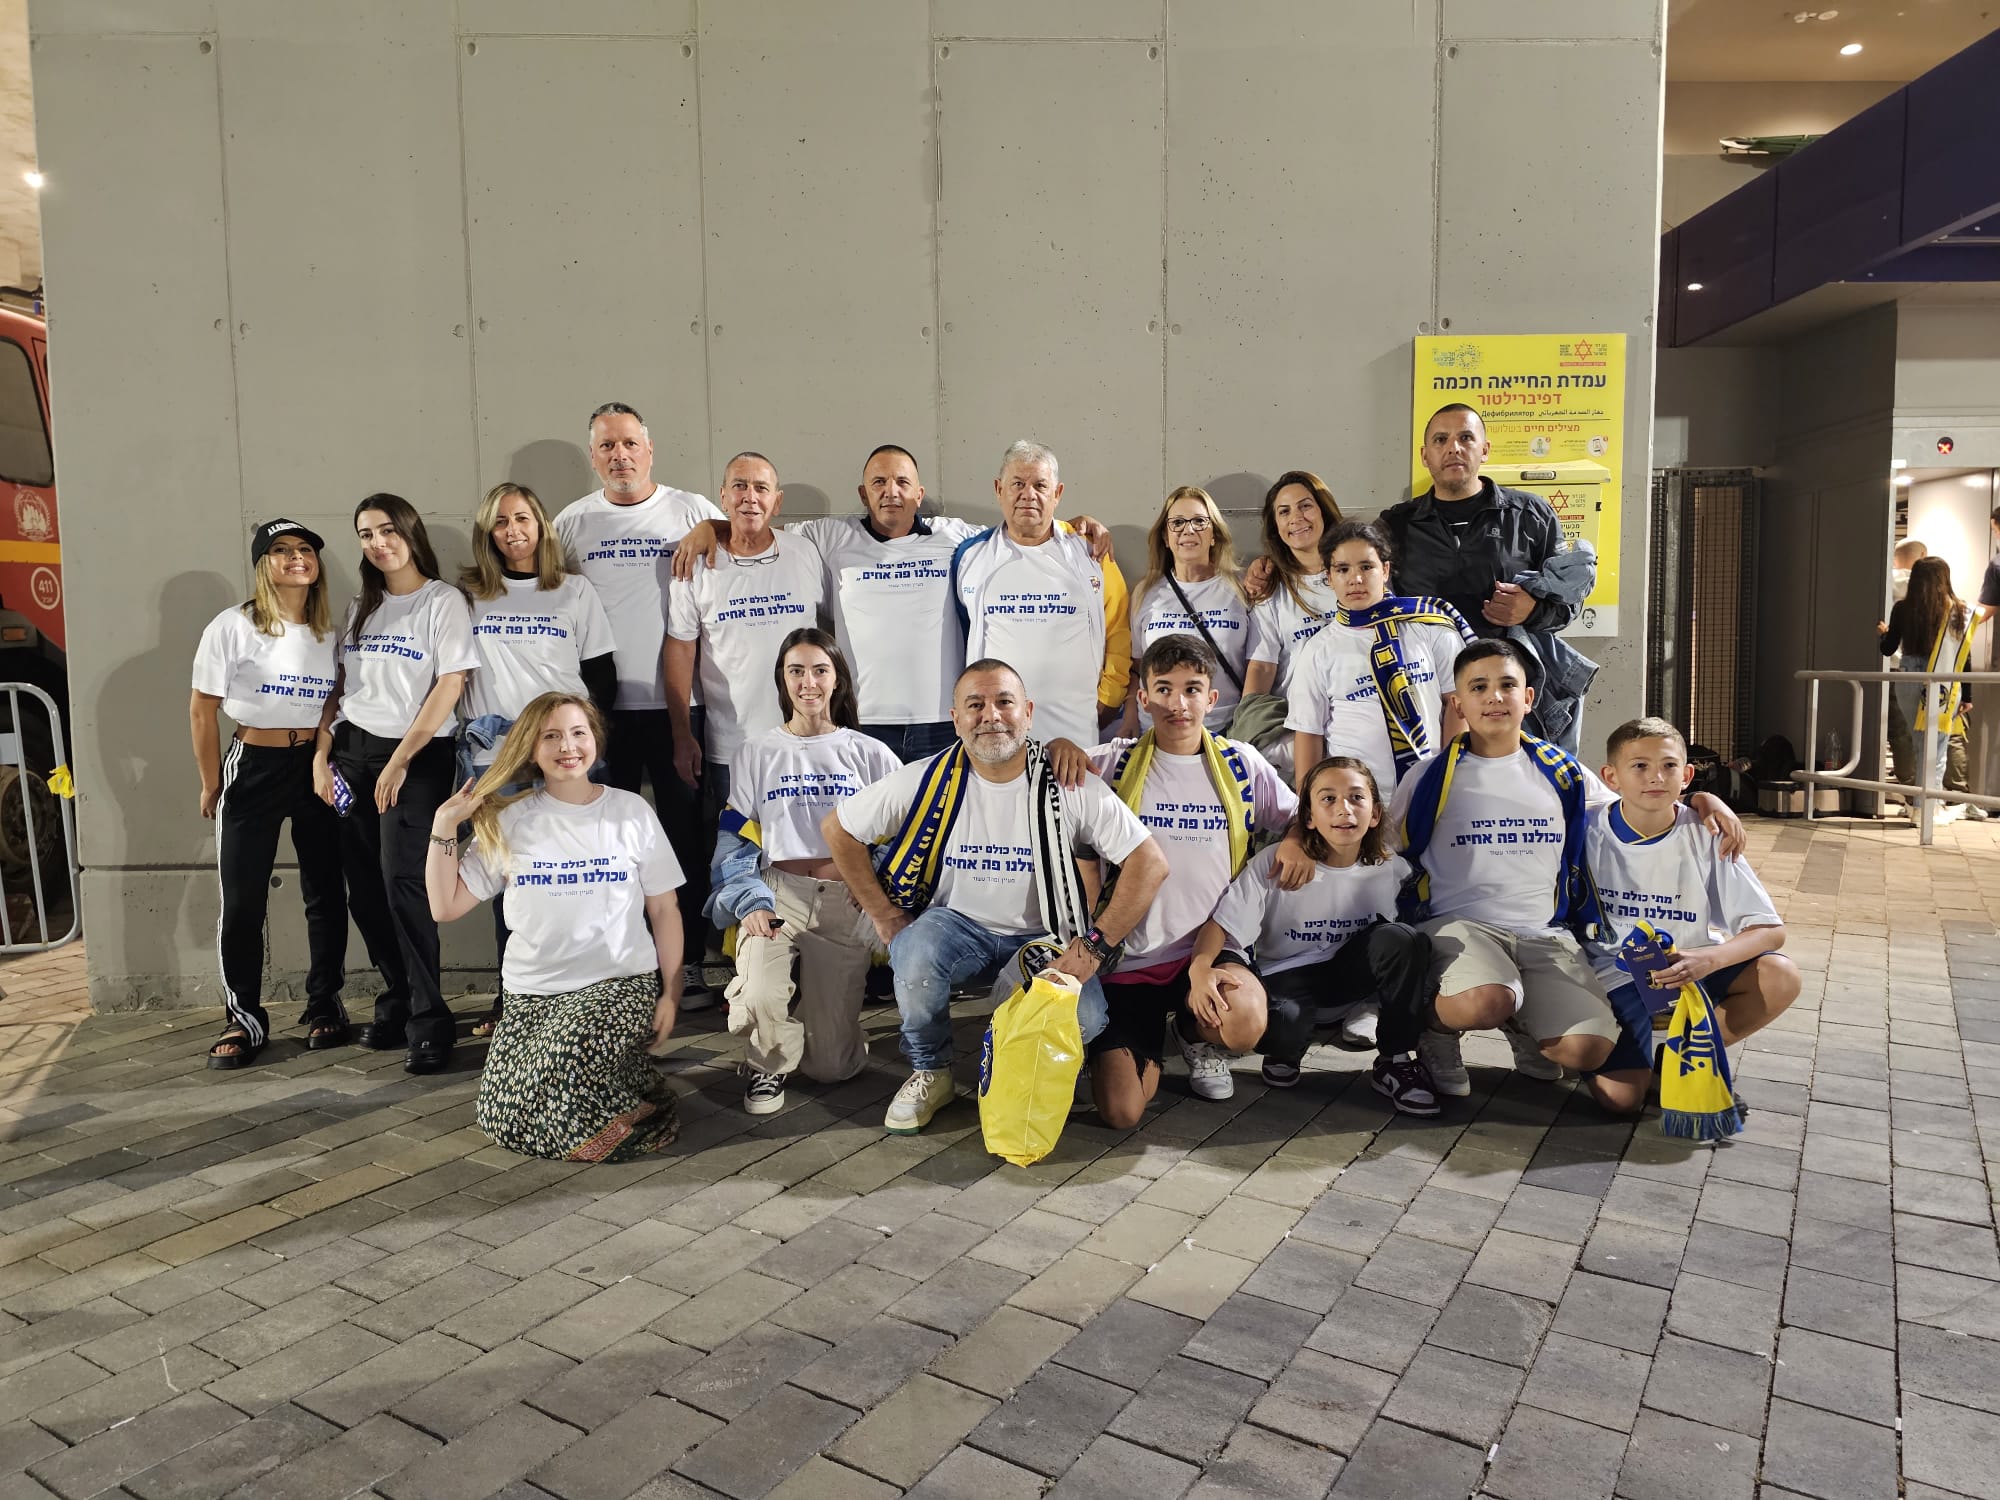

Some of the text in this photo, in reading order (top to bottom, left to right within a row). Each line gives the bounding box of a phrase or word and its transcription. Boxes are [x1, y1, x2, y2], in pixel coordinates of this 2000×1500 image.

[1433, 375, 1606, 390] עמדת החייאה חכמה
[1477, 391, 1562, 405] דפיברילטור
[1524, 424, 1545, 432] חיים
[1547, 424, 1580, 432] מצילים
[601, 539, 619, 547] יבינו
[621, 537, 642, 545] כולם
[619, 549, 636, 558] פה
[640, 547, 675, 558] כולנו
[896, 561, 916, 569] כולם
[894, 570, 911, 579] פה
[914, 567, 948, 578] שכולנו
[38, 579, 54, 593] 411
[729, 597, 747, 606] יבינו
[749, 595, 769, 604] כולם
[1021, 592, 1041, 601] כולם
[749, 607, 765, 617] פה
[768, 603, 805, 615] שכולנו
[1019, 605, 1035, 614] פה
[1039, 602, 1077, 615] שכולנו
[505, 626, 523, 634] פה
[1179, 621, 1195, 629] פה
[527, 624, 567, 639] שכולנו
[363, 644, 380, 652] פה
[381, 643, 424, 660] שכולנו
[279, 674, 300, 682] יבינו
[302, 675, 323, 685] כולם
[298, 688, 314, 698] פה
[780, 775, 801, 783] יבינו
[804, 773, 826, 781] כולם
[802, 786, 820, 796] פה
[1156, 803, 1178, 812] יבינו
[1182, 803, 1206, 813] כולם
[1178, 818, 1198, 830] פה
[1471, 819, 1496, 829] יבינו
[1499, 817, 1525, 828] כולם
[1497, 832, 1518, 844] פה
[1522, 829, 1563, 844] שכולנו
[960, 844, 983, 853] יבינו
[985, 843, 1010, 855] כולם
[532, 861, 557, 869] יבינו
[561, 860, 586, 869] כולם
[981, 859, 1001, 871] פה
[557, 873, 578, 885] פה
[583, 868, 628, 883] שכולנו
[1622, 890, 1648, 902] כולם
[1618, 904, 1640, 918] פה
[1644, 905, 1697, 923] שכולנו
[1304, 919, 1327, 929] יבינו
[1329, 918, 1352, 929] כולם
[1326, 932, 1343, 943] פה
